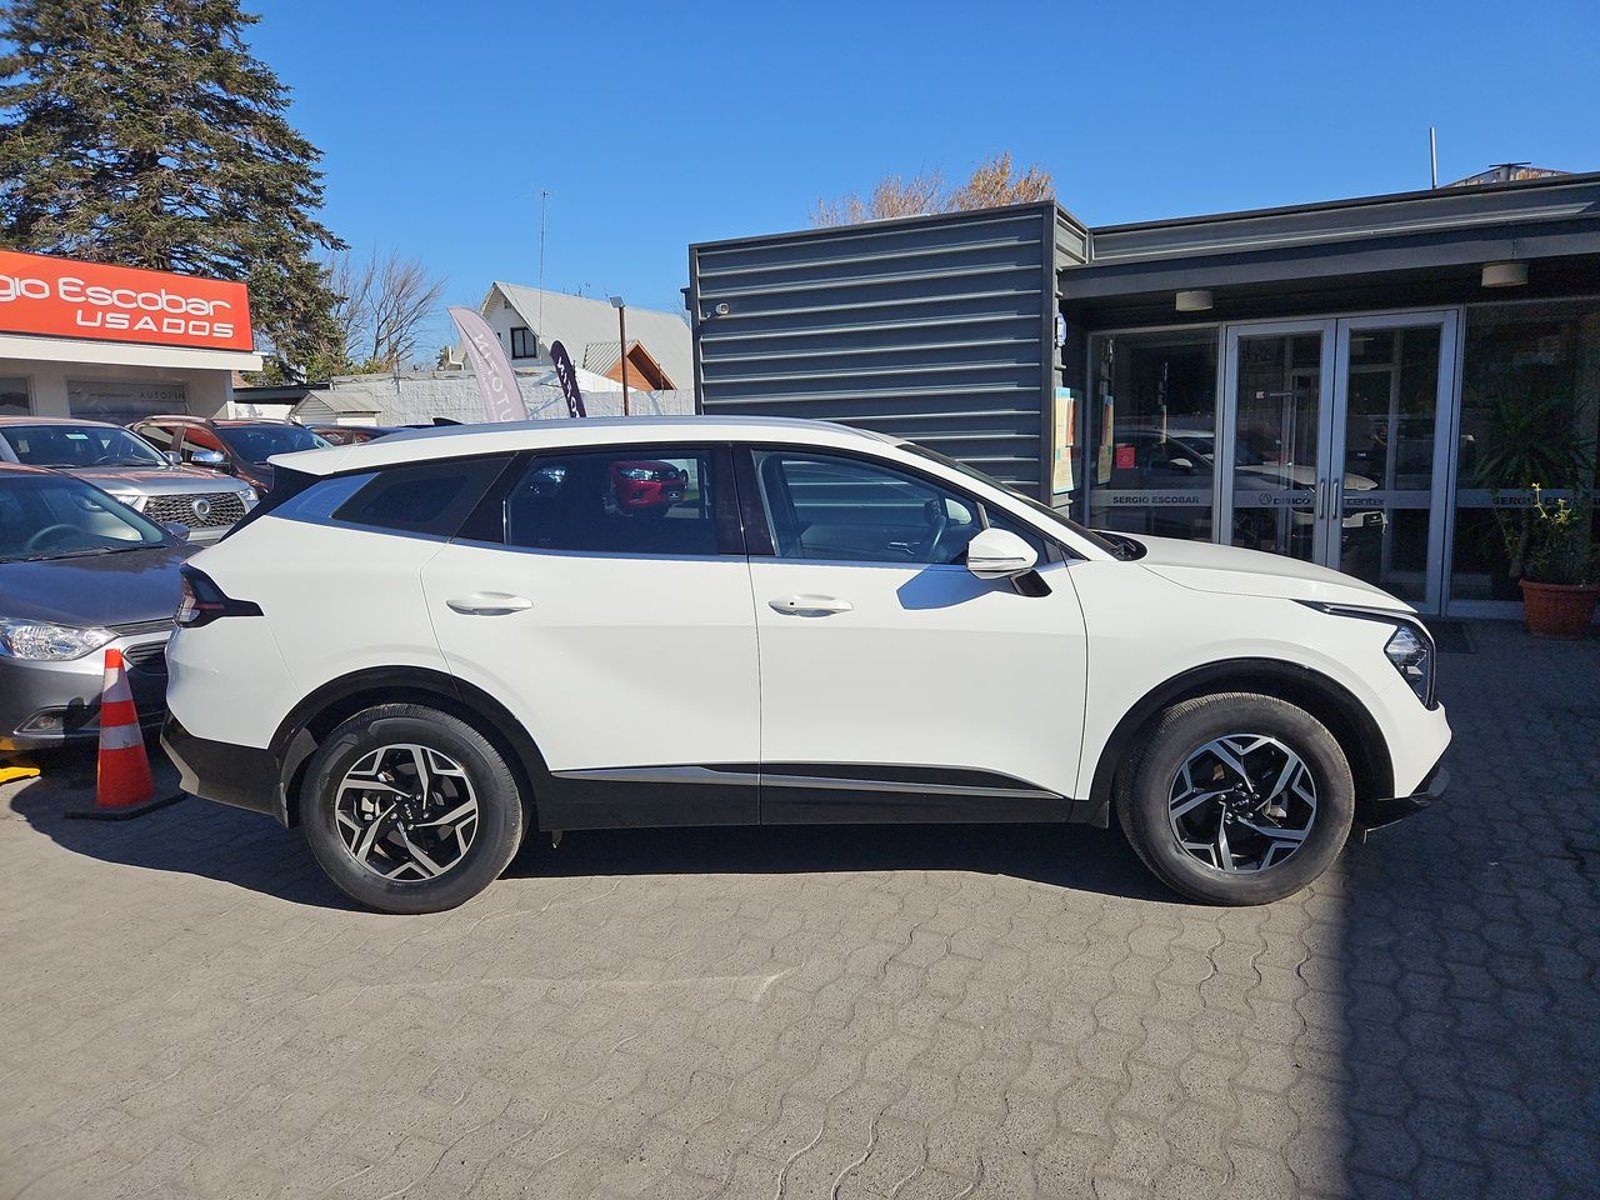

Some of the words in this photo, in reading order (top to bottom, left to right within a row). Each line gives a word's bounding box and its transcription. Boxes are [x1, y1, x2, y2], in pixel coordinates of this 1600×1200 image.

[58, 277, 231, 316] Escobar
[77, 309, 234, 338] USADOS
[1112, 495, 1149, 504] SERGIO
[1152, 495, 1199, 504] ESCOBAR
